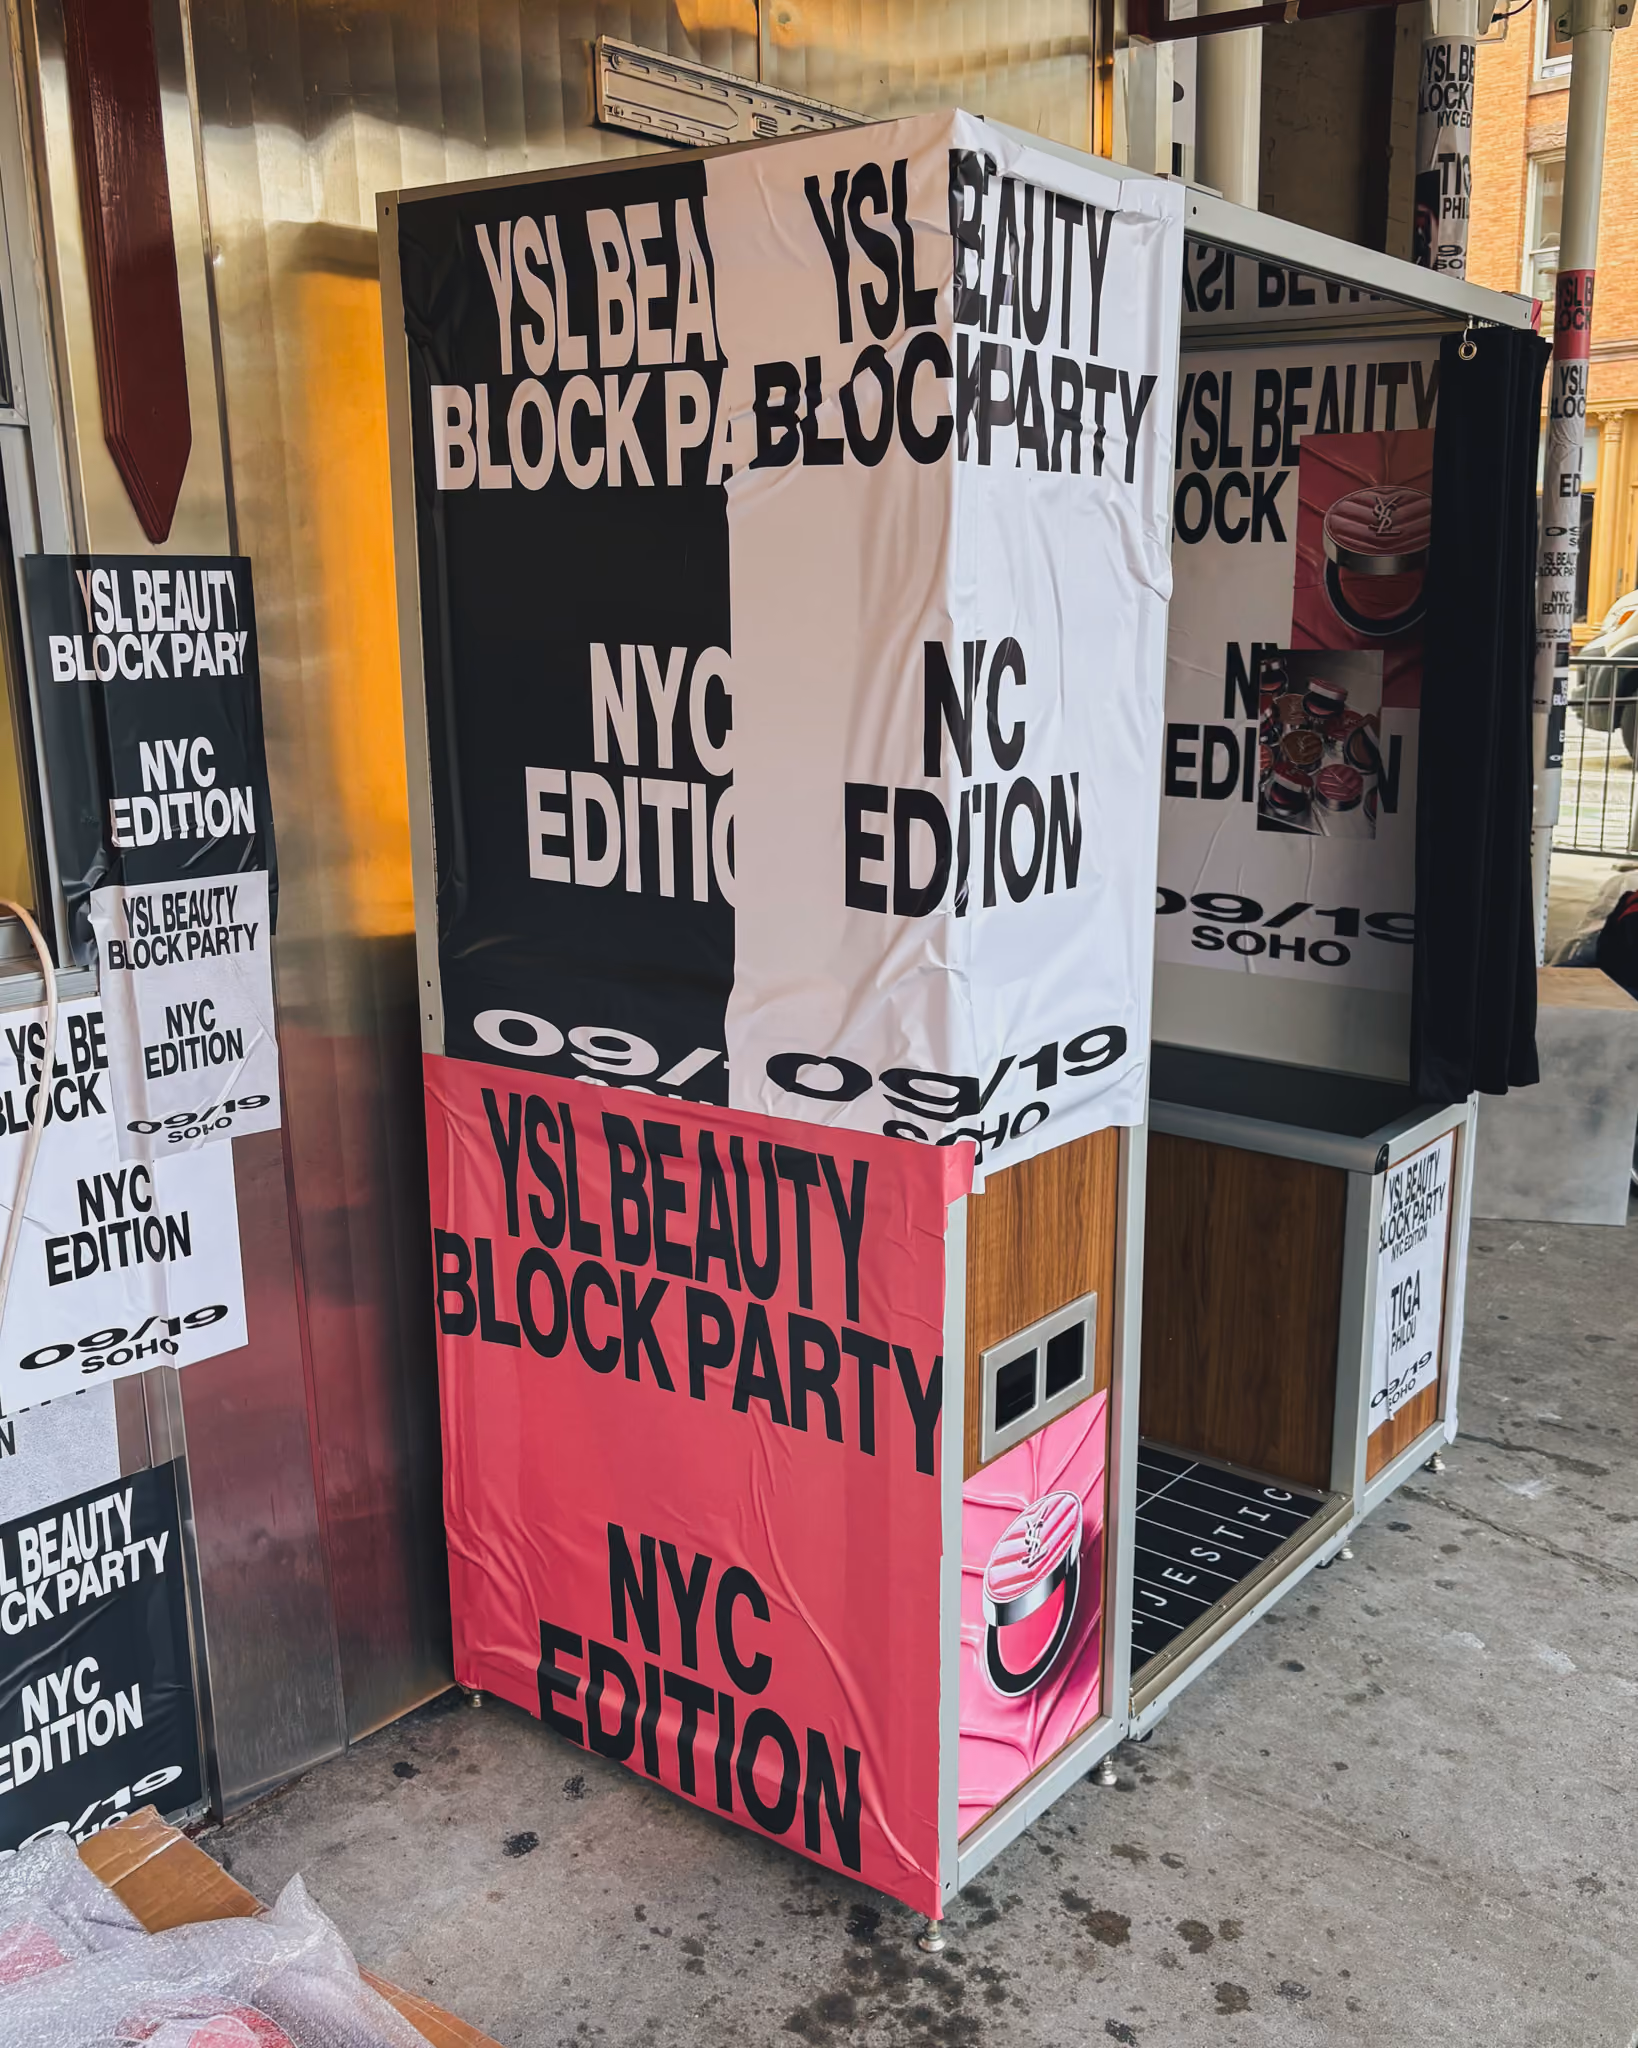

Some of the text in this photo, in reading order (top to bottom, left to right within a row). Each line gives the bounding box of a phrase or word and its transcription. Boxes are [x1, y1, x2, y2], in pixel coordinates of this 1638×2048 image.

[1426, 44, 1456, 83] YSL
[803, 158, 938, 344] YSL
[475, 215, 588, 376] YSL
[749, 331, 1158, 484] BLOCK PARTY
[1551, 396, 1585, 418] LOC
[1560, 365, 1585, 396] YSL
[430, 372, 655, 491] BLOCK
[1173, 470, 1290, 544] OCK
[76, 569, 132, 633] YSL
[49, 630, 248, 682] BLOCK PARY
[590, 642, 734, 777] NYC
[139, 736, 216, 792] NYC
[1165, 723, 1403, 814] EDIN
[109, 785, 256, 848] EDITION
[122, 884, 238, 938] YSL BEAUTY
[107, 922, 259, 970] BLOCK PARTY
[1190, 925, 1351, 966] SOHO
[165, 998, 216, 1039] NYC
[144, 1028, 244, 1080] EDITION
[765, 1025, 1127, 1123] 09/19
[0, 1072, 107, 1137] LOCK
[127, 1094, 271, 1134] 09/19
[77, 1165, 152, 1226] NYC
[481, 1088, 869, 1323] YSL BEAUTY
[1404, 1147, 1440, 1206] BEAUTY
[1412, 1181, 1446, 1230] PARTY
[45, 1211, 192, 1287] EDITION
[1391, 1269, 1420, 1331] TIGA
[19, 1304, 228, 1370] 09/19
[81, 1337, 179, 1374] SOHO
[433, 1227, 943, 1477] BLOCK PARTY
[18, 1487, 133, 1587] BEAUTY
[57, 1531, 169, 1614] PARTY
[607, 1521, 773, 1695] NYC
[20, 1656, 100, 1732] NYC
[537, 1619, 861, 1873] EDITION
